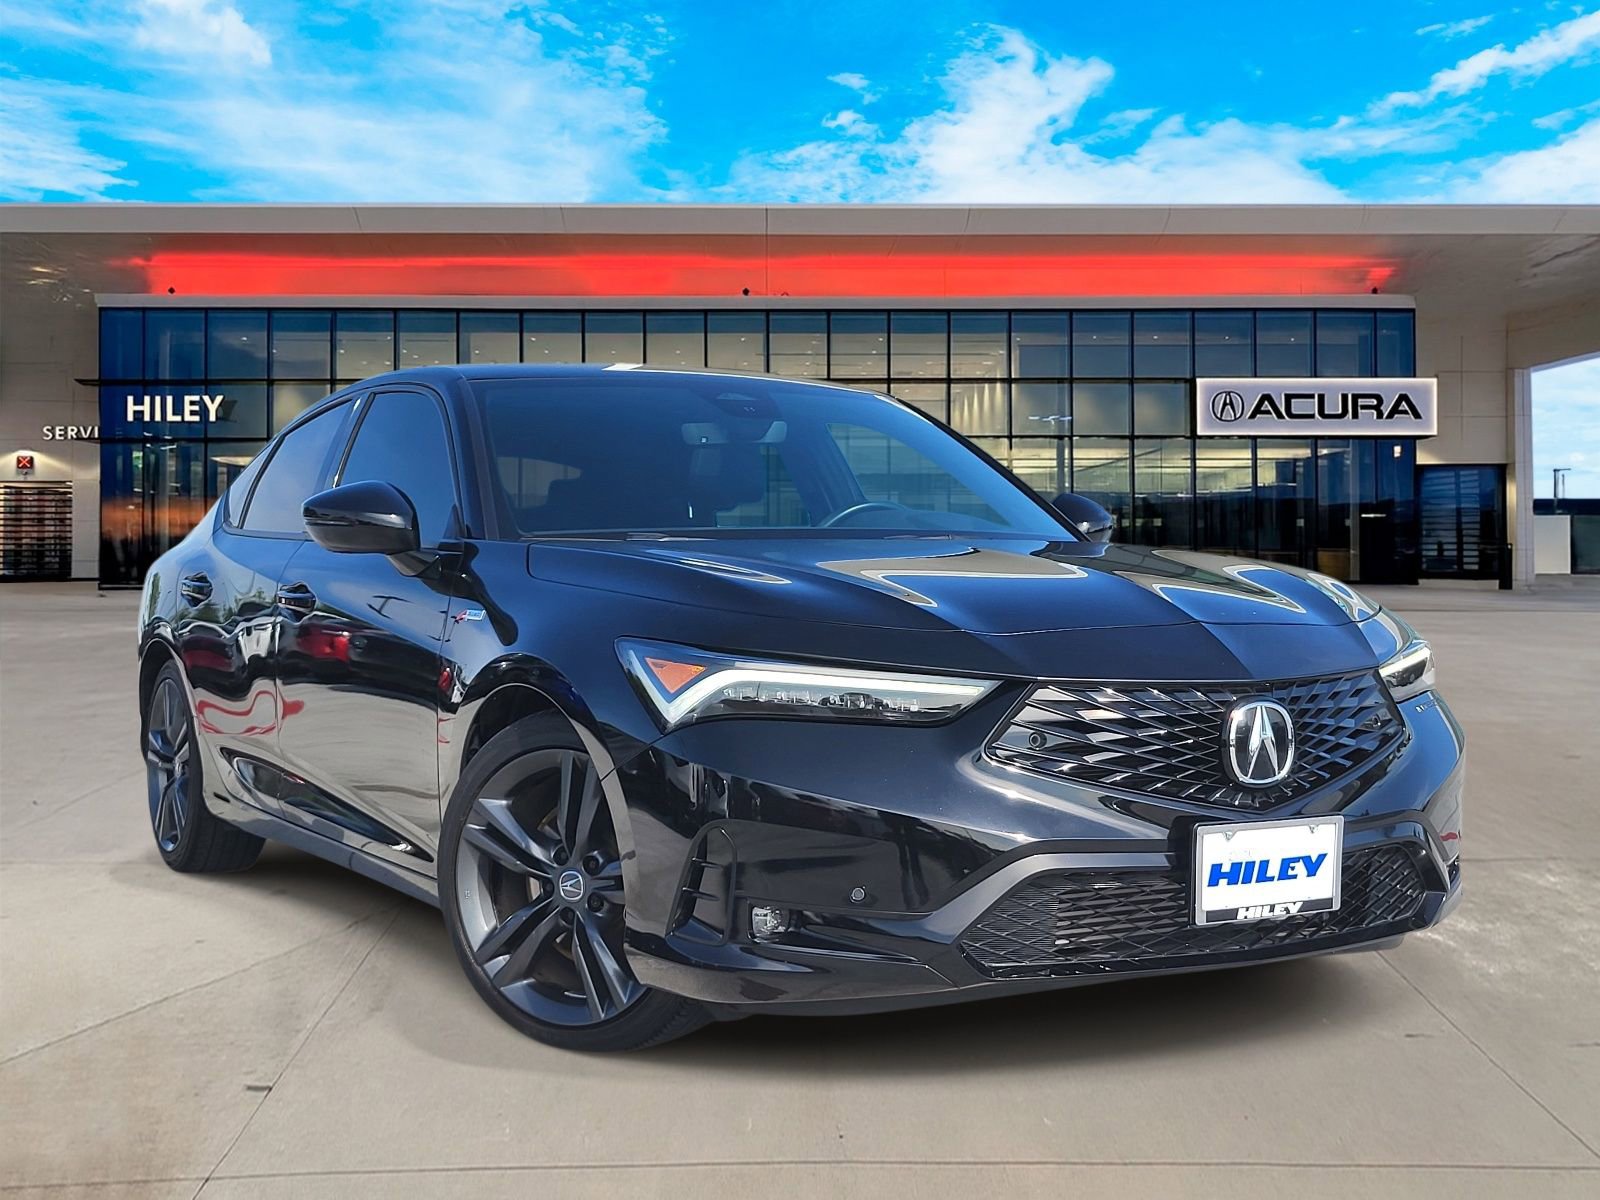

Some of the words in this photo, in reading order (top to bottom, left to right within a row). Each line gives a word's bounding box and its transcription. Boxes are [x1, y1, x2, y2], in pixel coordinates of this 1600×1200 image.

[126, 395, 224, 422] HILEY
[1248, 392, 1422, 420] ACURA
[42, 425, 99, 440] SERVI
[1207, 852, 1328, 887] HILEY
[1236, 901, 1303, 920] HILEY
